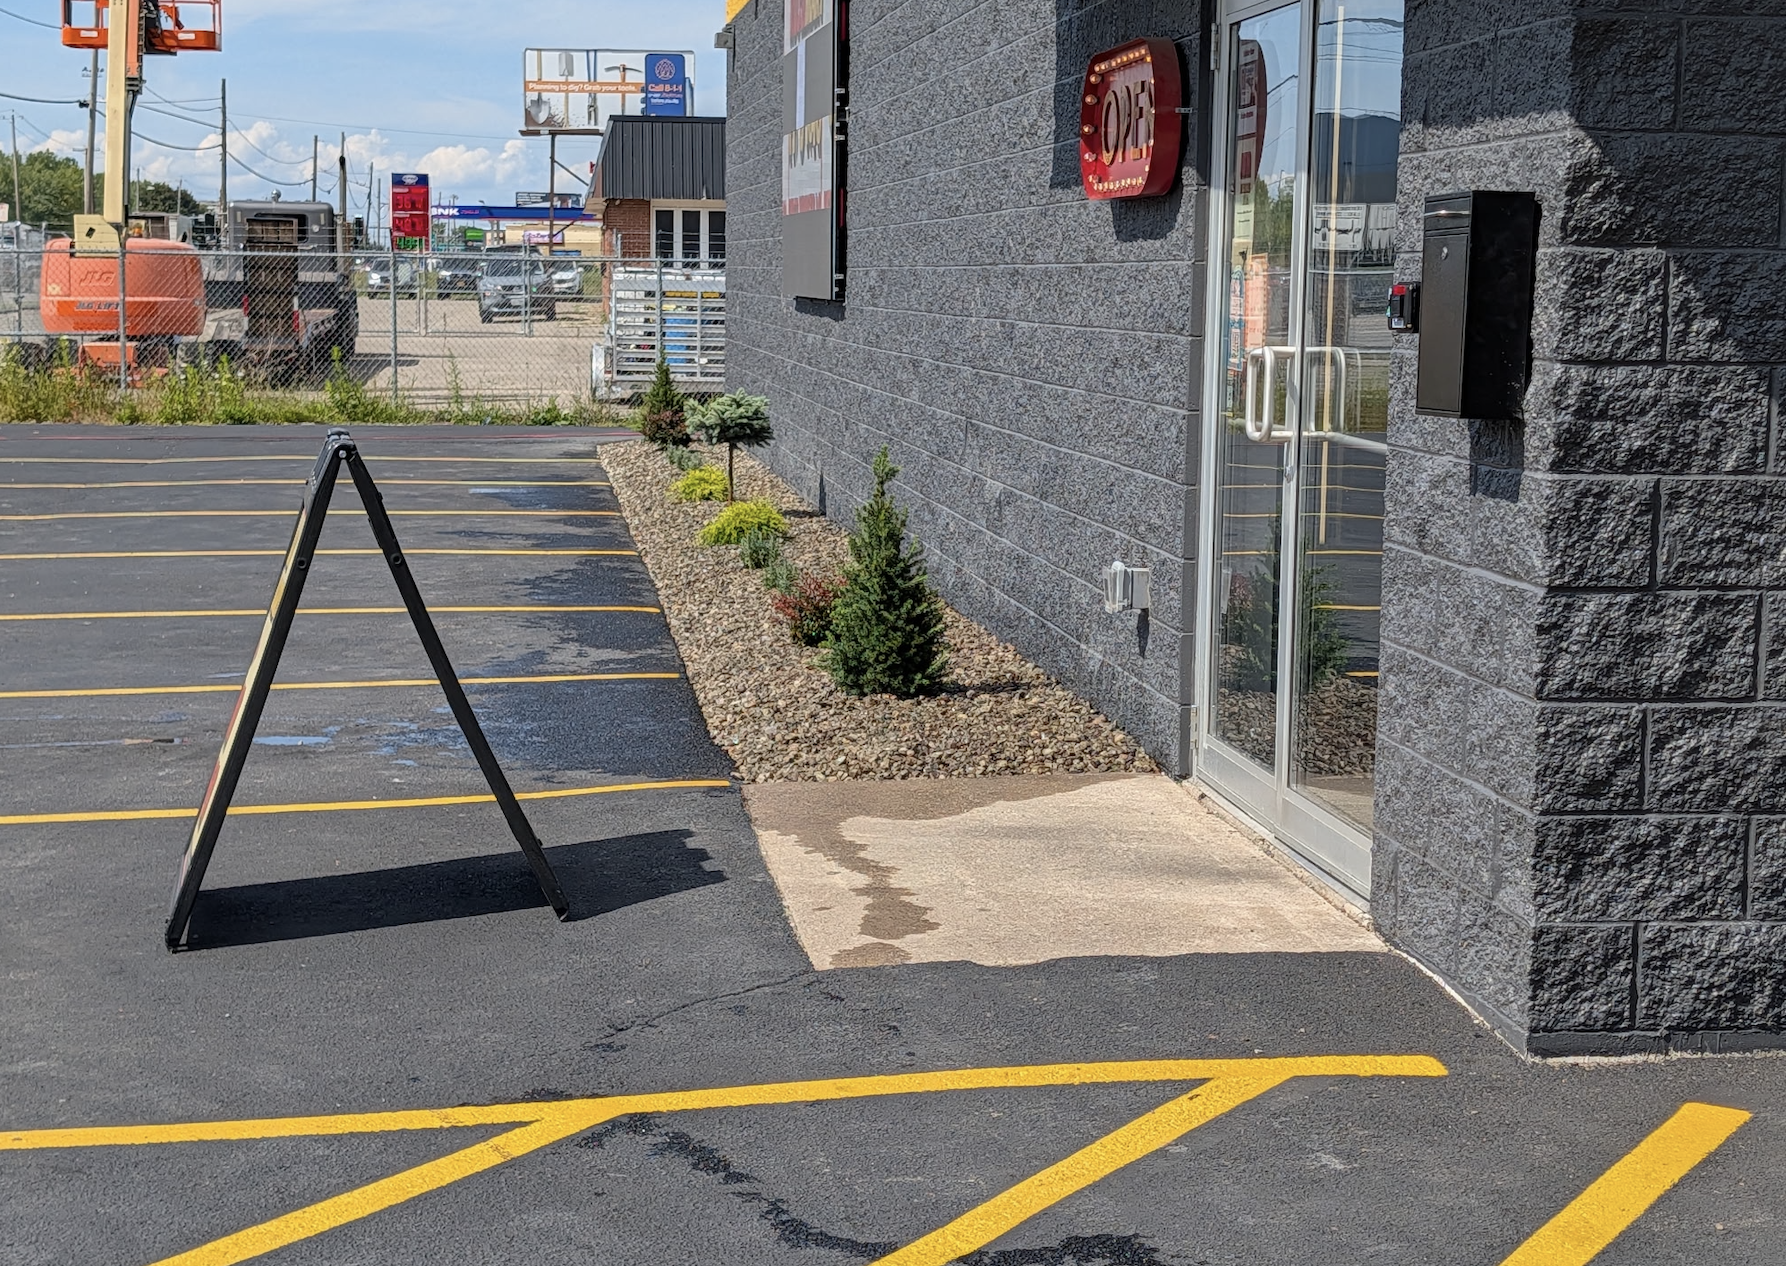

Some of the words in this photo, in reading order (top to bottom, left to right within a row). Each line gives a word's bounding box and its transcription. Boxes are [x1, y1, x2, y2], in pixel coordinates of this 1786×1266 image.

[560, 83, 567, 91] to
[648, 83, 664, 92] Call
[1101, 79, 1155, 166] OPEN
[79, 270, 116, 286] JLG
[75, 301, 94, 310] JLG
